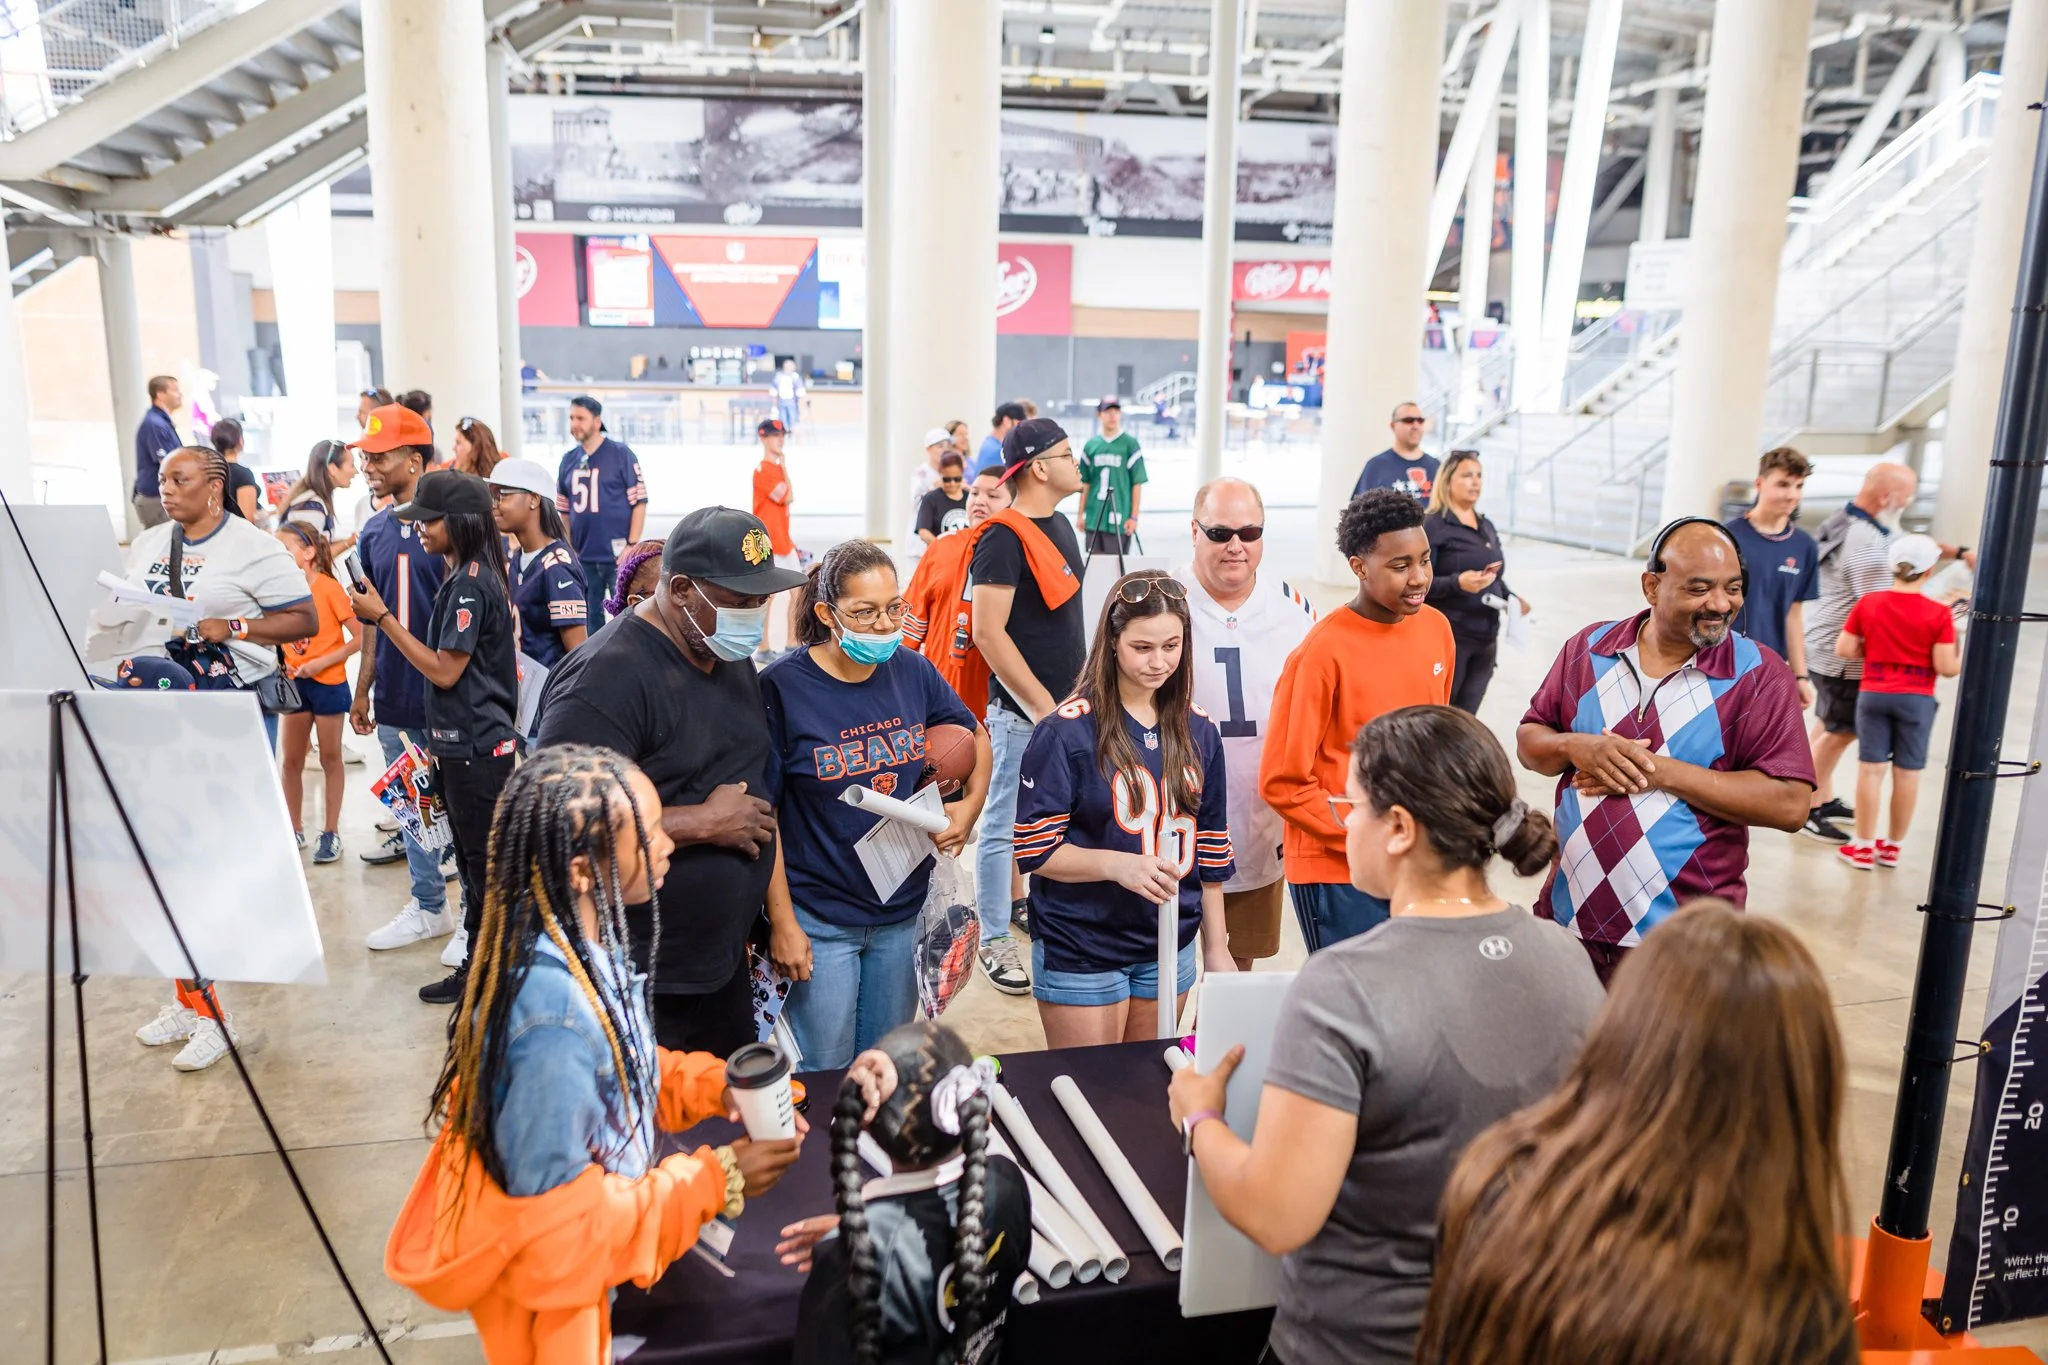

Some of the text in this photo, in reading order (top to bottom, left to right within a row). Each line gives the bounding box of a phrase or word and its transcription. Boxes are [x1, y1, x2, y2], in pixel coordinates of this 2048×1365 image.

[571, 467, 600, 514] 51
[148, 562, 203, 576] BERS
[1213, 646, 1258, 738] 1
[840, 716, 903, 740] CHICAGO
[813, 722, 926, 781] BEARS
[1112, 765, 1203, 881] 96
[2023, 1100, 2045, 1131] 20
[2001, 1205, 2021, 1232] 10
[2003, 1268, 2040, 1282] reflect
